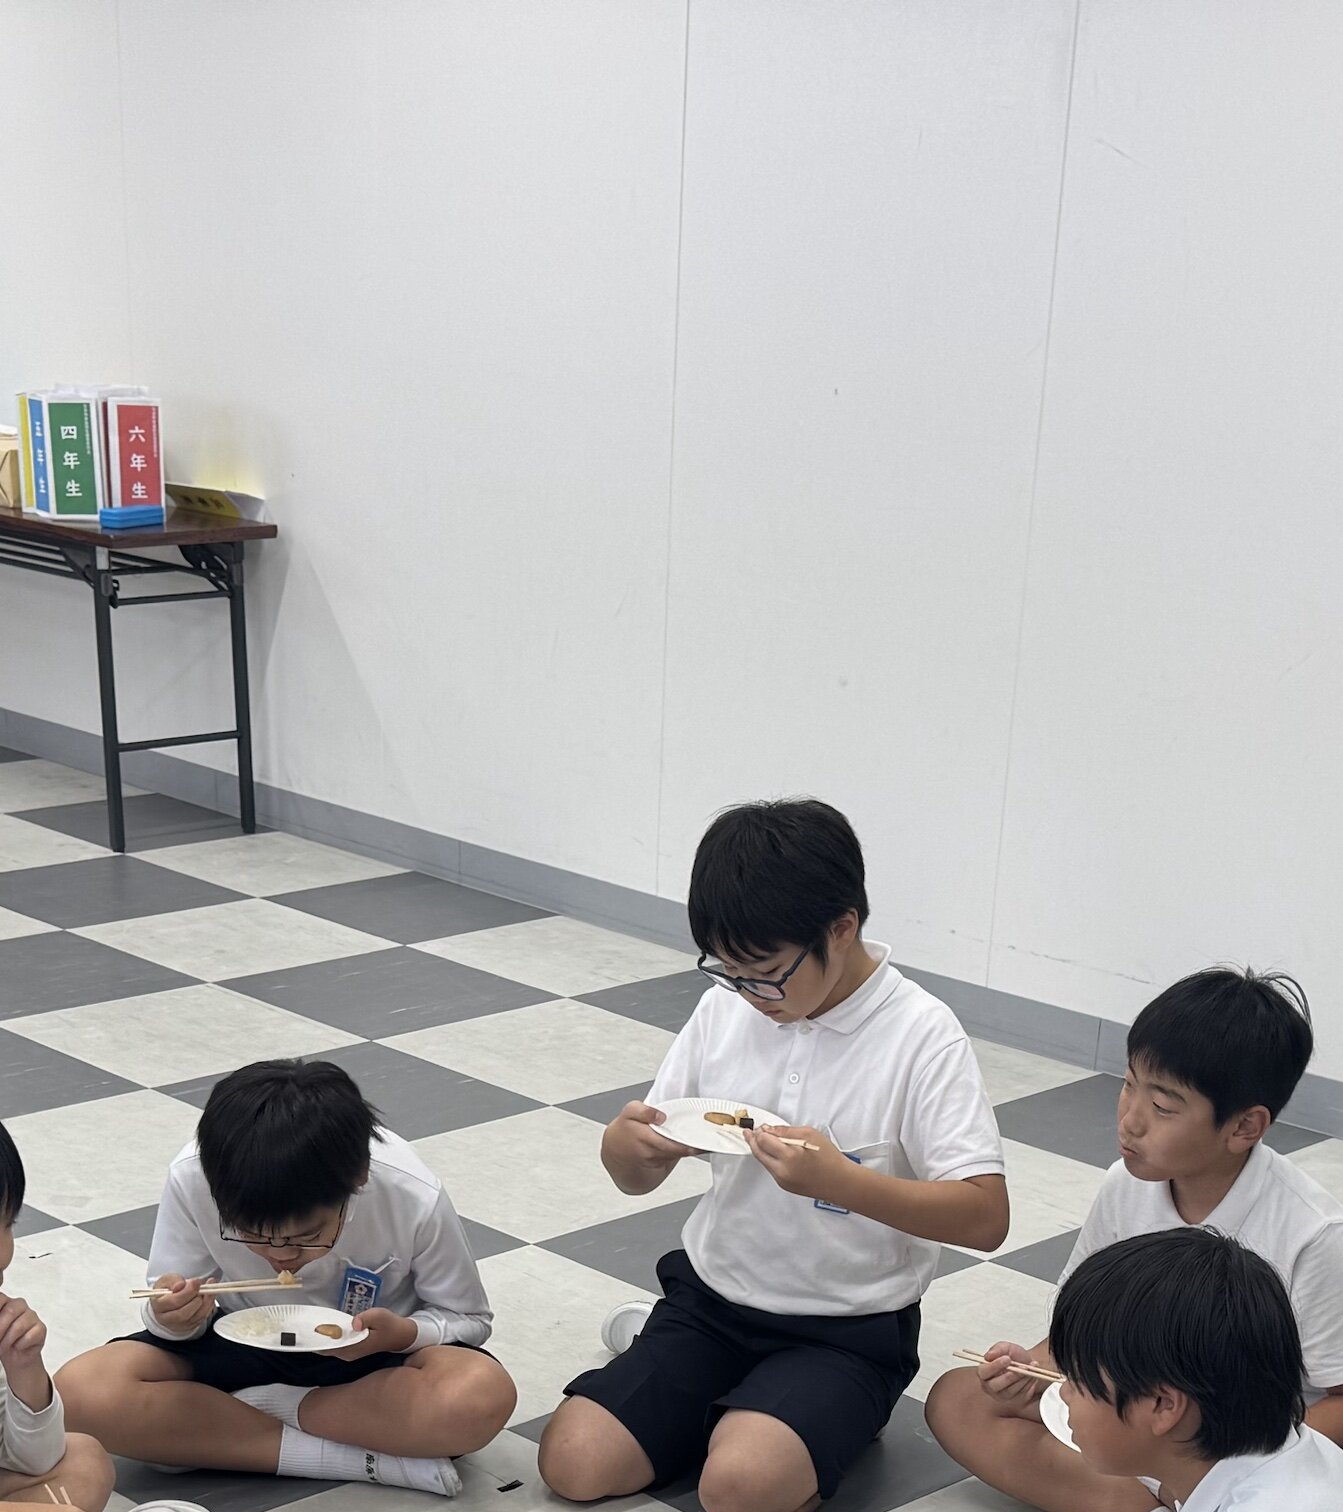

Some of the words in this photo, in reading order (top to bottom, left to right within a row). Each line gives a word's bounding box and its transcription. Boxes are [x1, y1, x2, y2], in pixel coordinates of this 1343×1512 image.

[60, 425, 83, 497] 四年生
[128, 425, 149, 499] 六年生
